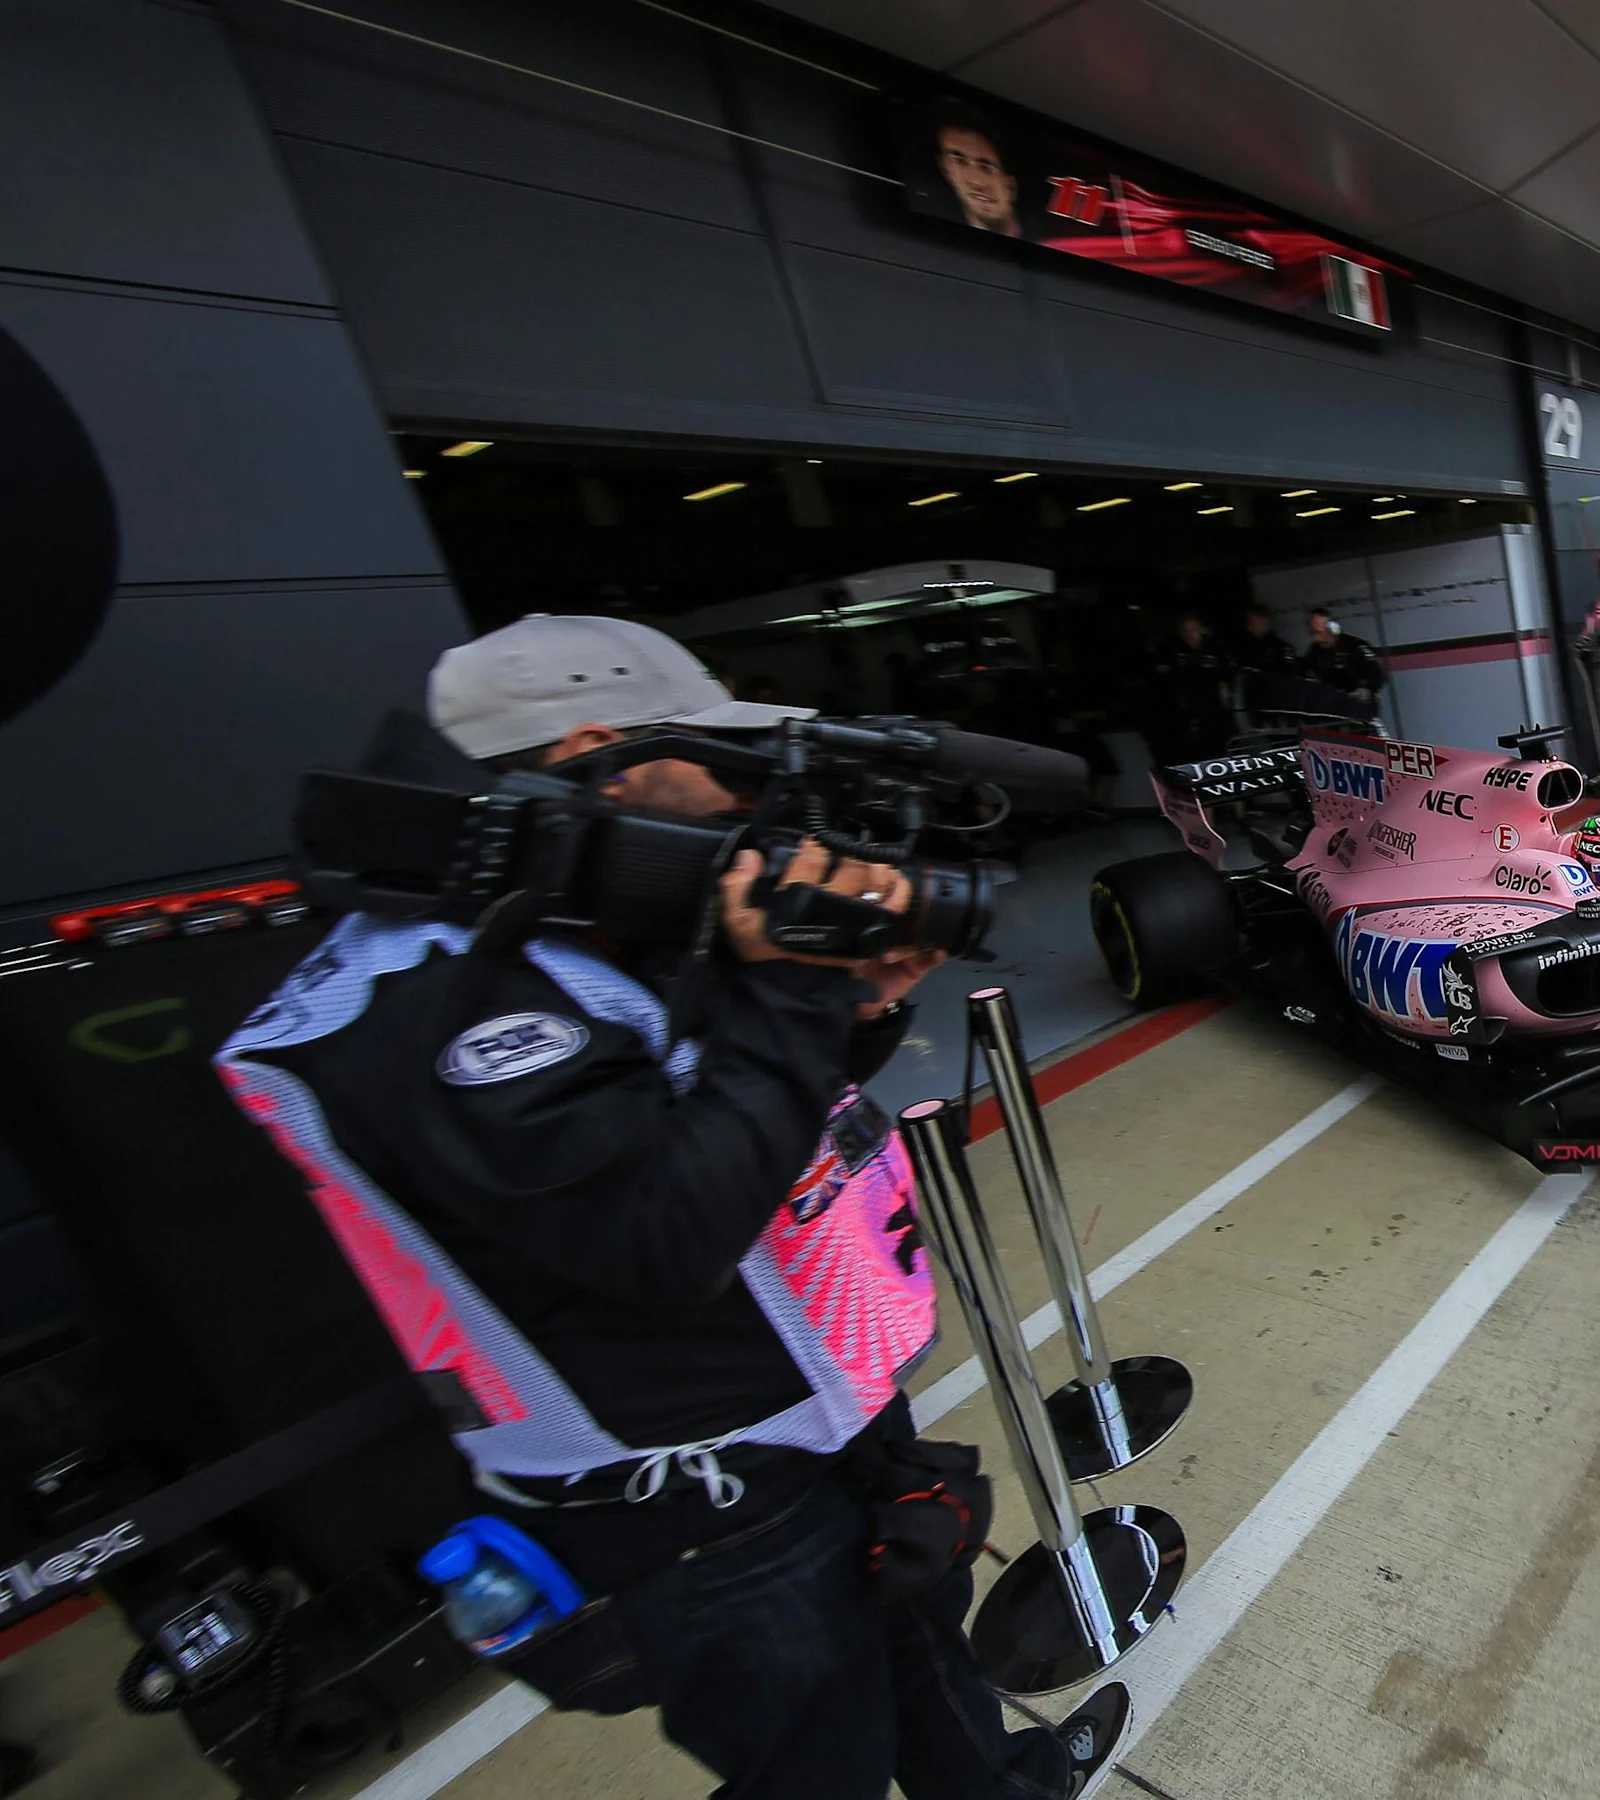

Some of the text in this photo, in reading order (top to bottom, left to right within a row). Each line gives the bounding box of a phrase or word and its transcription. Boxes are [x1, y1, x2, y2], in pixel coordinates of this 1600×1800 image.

[1539, 391, 1583, 461] 29
[1387, 744, 1435, 776] PER
[1329, 757, 1385, 805] BWT
[1481, 766, 1535, 793] HYPE
[1418, 789, 1476, 821] NEC
[1499, 825, 1514, 851] E
[1580, 841, 1600, 853] NEC
[1494, 865, 1542, 896] Claro
[1572, 883, 1596, 899] BWT
[1463, 930, 1536, 954] LDNR.biz
[1350, 930, 1464, 1020] BWT
